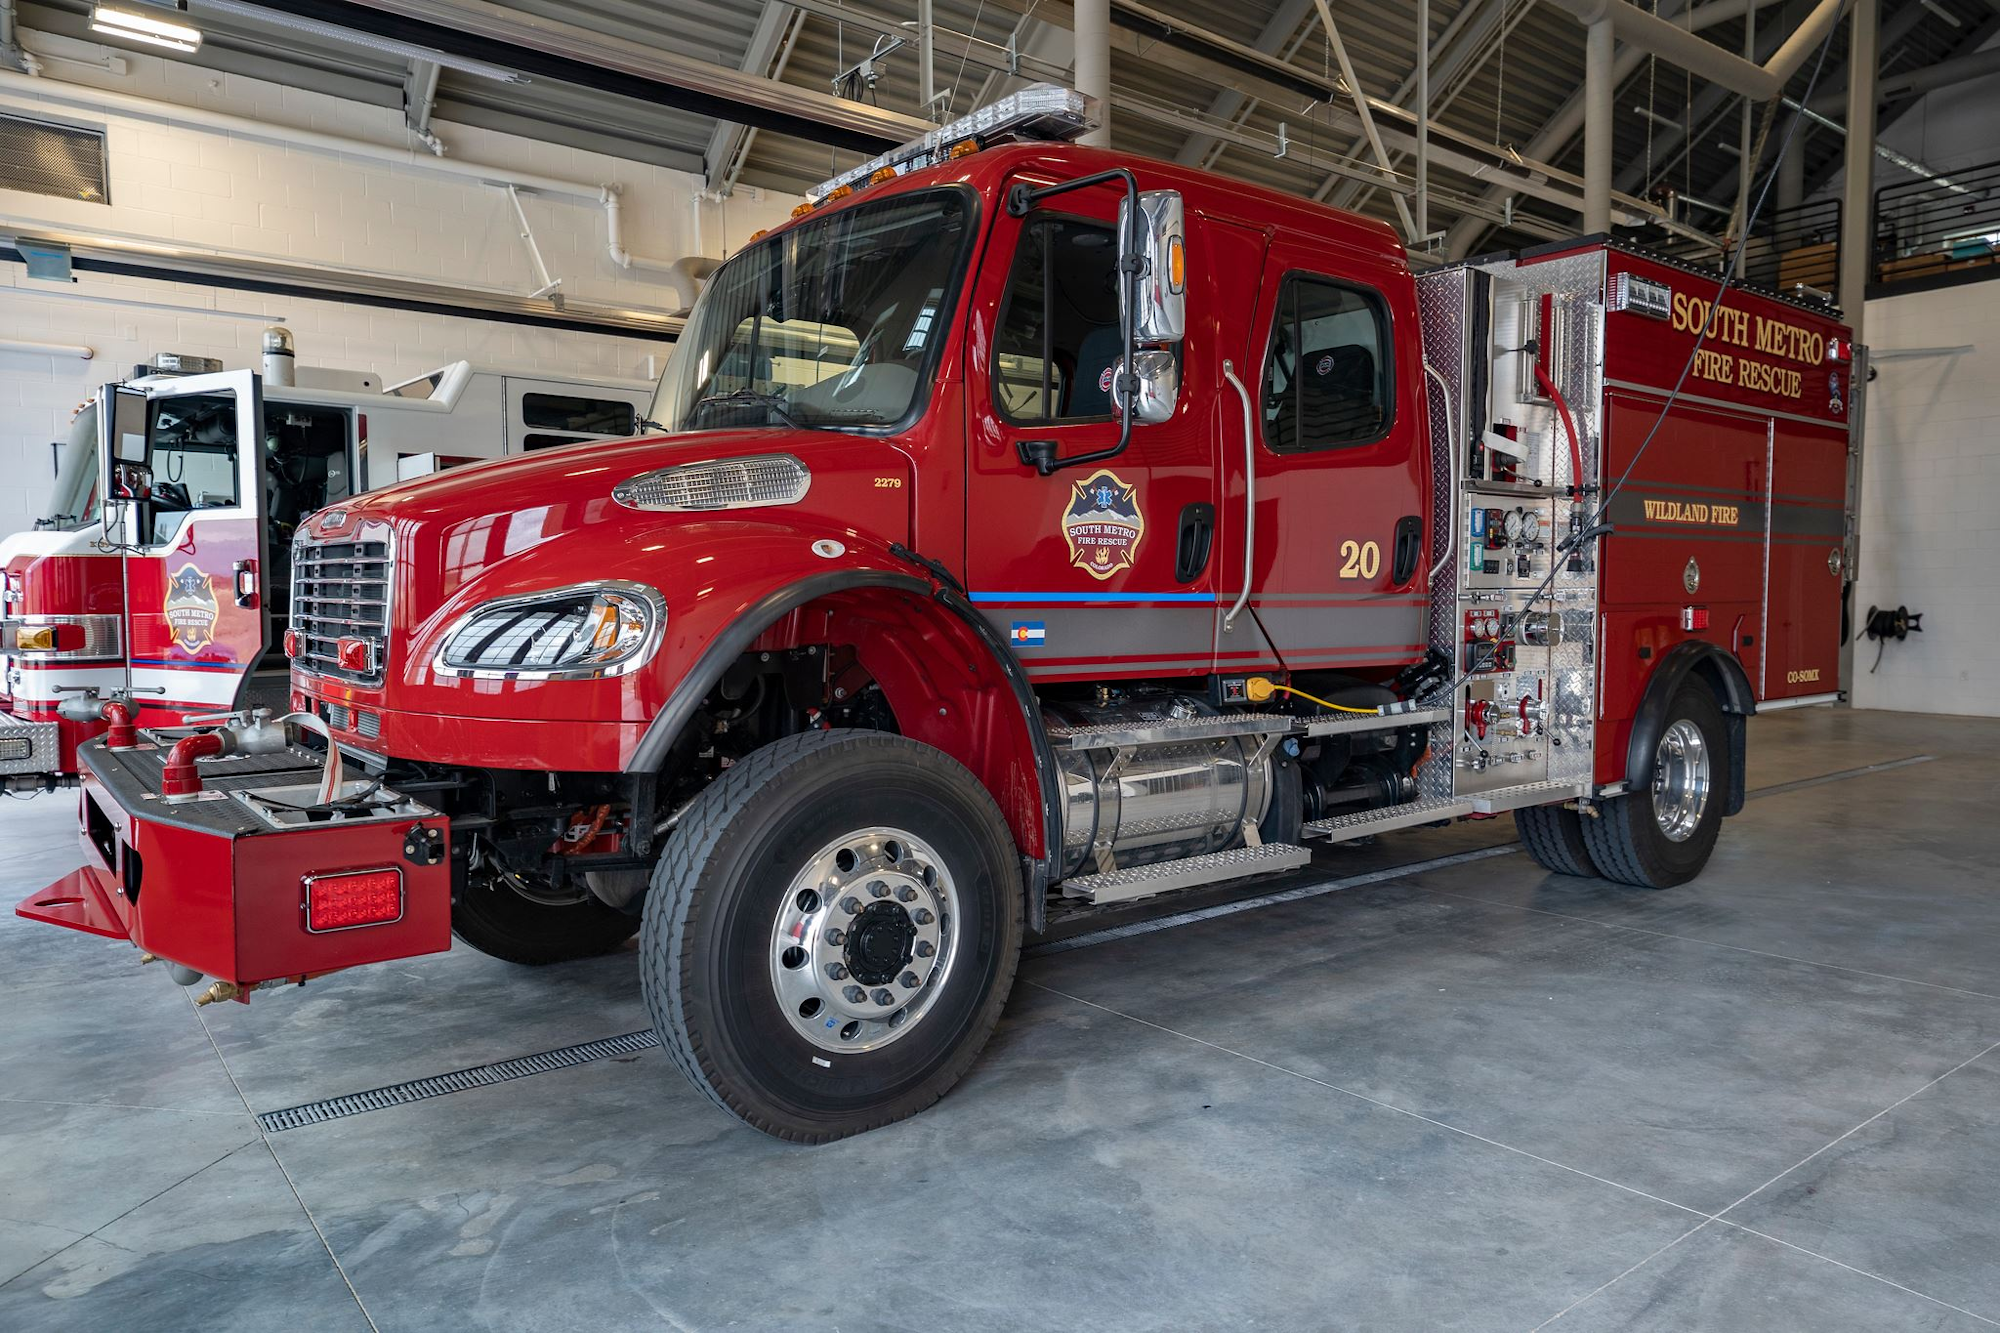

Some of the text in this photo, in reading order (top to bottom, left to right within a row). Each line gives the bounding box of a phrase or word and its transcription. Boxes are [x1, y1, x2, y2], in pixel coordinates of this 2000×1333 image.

[1672, 292, 1823, 366] SOUTH METRO
[1692, 348, 1802, 399] FIRE RESCUE
[874, 477, 902, 488] 2279
[1644, 500, 1739, 525] WILDLAND FIRE
[1069, 525, 1136, 539] SOUTH METRO
[1077, 536, 1128, 546] FIRE RESCUE
[1340, 540, 1380, 579] 20
[169, 609, 214, 621] SOUTH METRO
[174, 618, 209, 627] FIRE RESCUE
